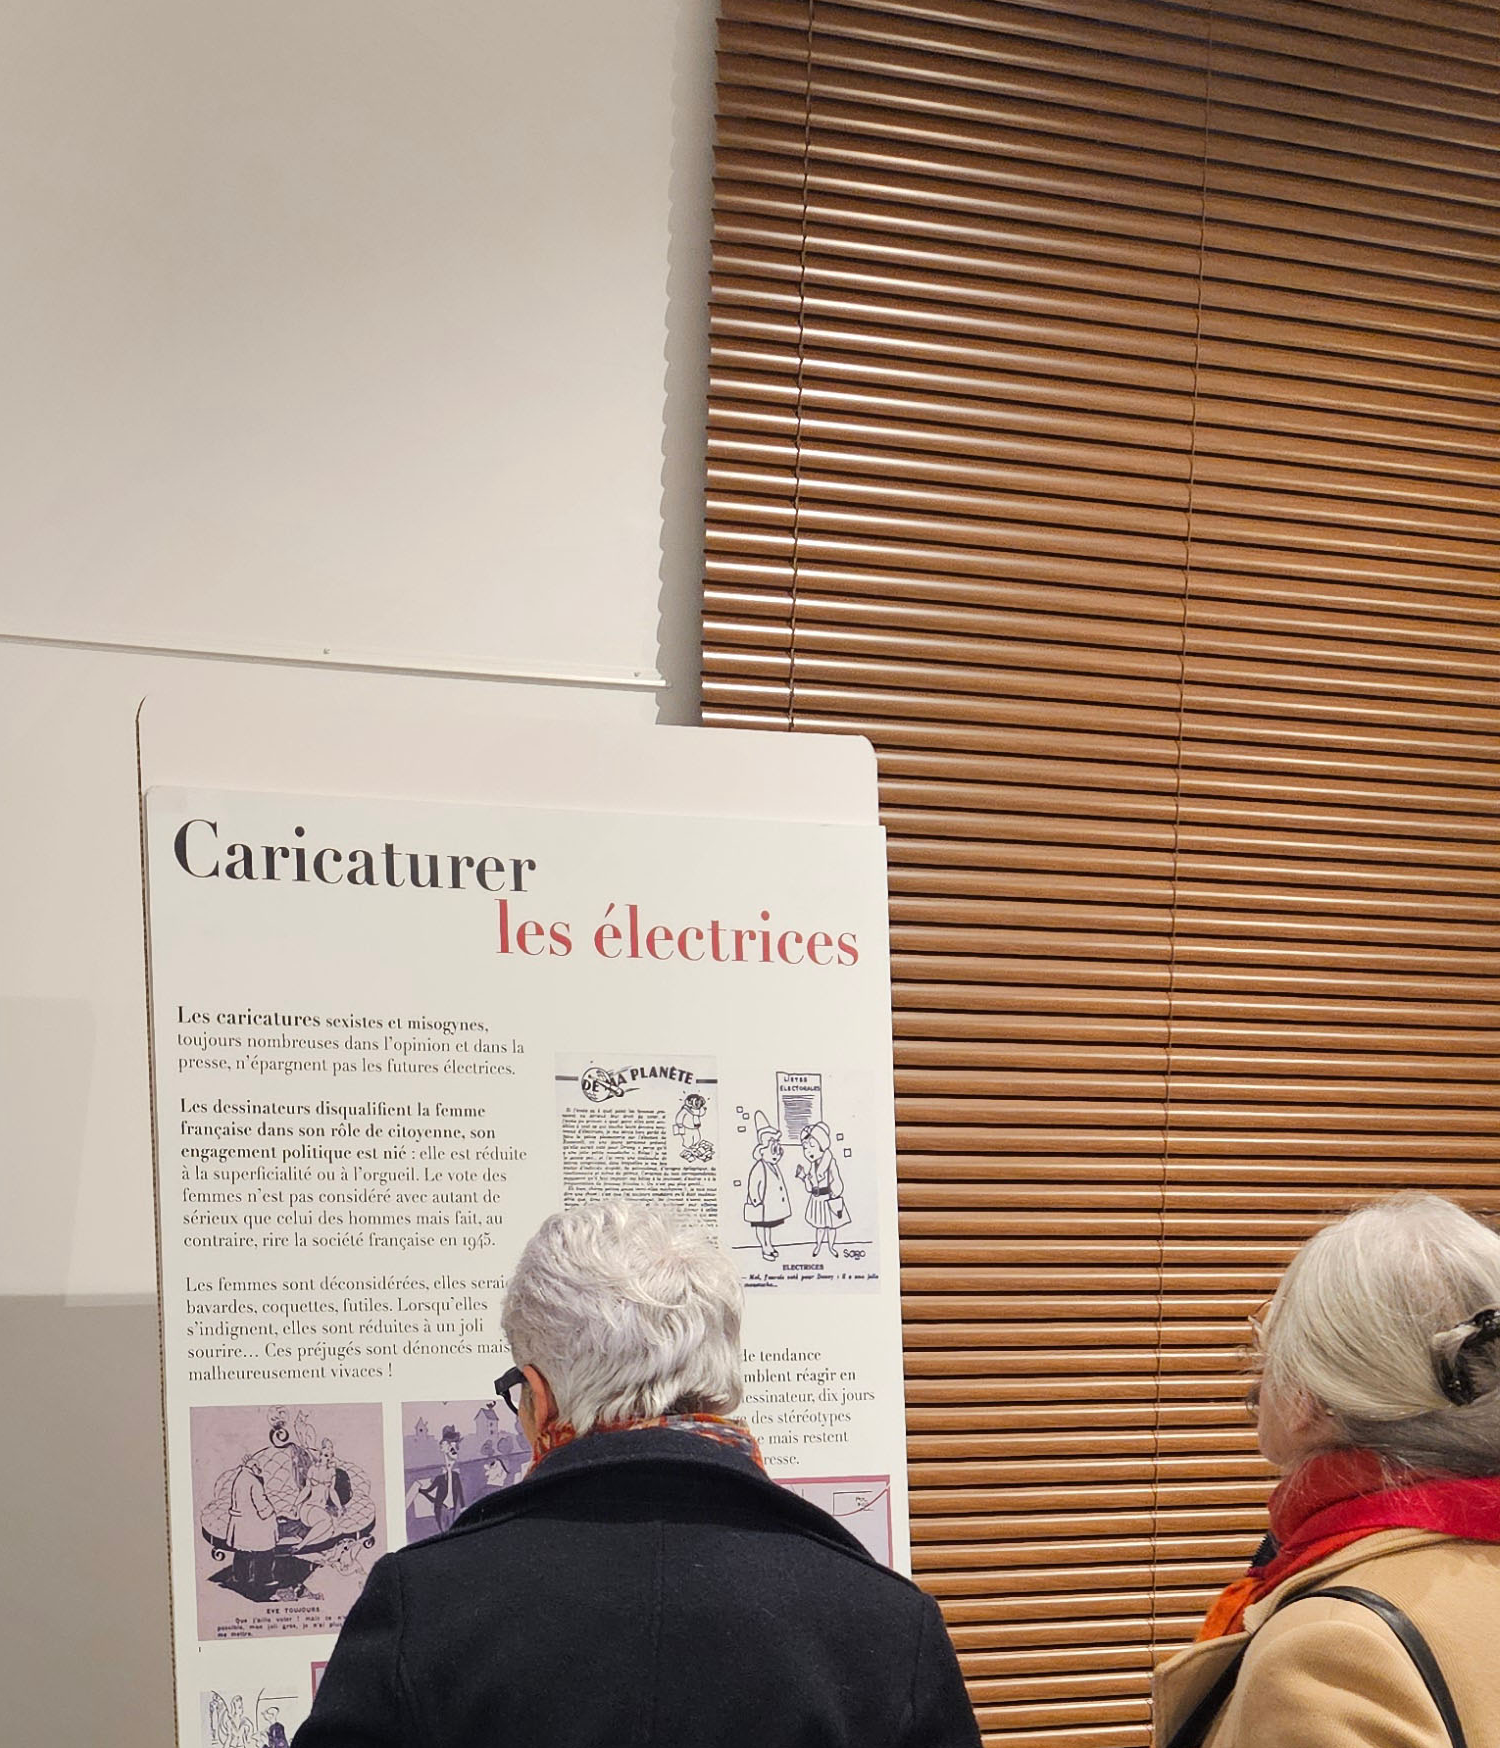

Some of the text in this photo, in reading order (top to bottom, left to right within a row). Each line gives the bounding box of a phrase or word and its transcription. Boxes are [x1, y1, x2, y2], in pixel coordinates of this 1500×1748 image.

[174, 818, 536, 893] Caricaturer
[494, 899, 860, 967] les électrices
[178, 1005, 489, 1036] Les caricatures sexistes et misogynes,
[180, 1097, 486, 1121] Les dessinateurs disqualifient la femme
[183, 1231, 496, 1251] contraire, rire la société française en 1945.
[760, 1347, 821, 1361] tendance
[796, 1367, 837, 1385] réagir
[840, 1371, 856, 1381] en
[751, 1409, 851, 1427] des stéréotypes
